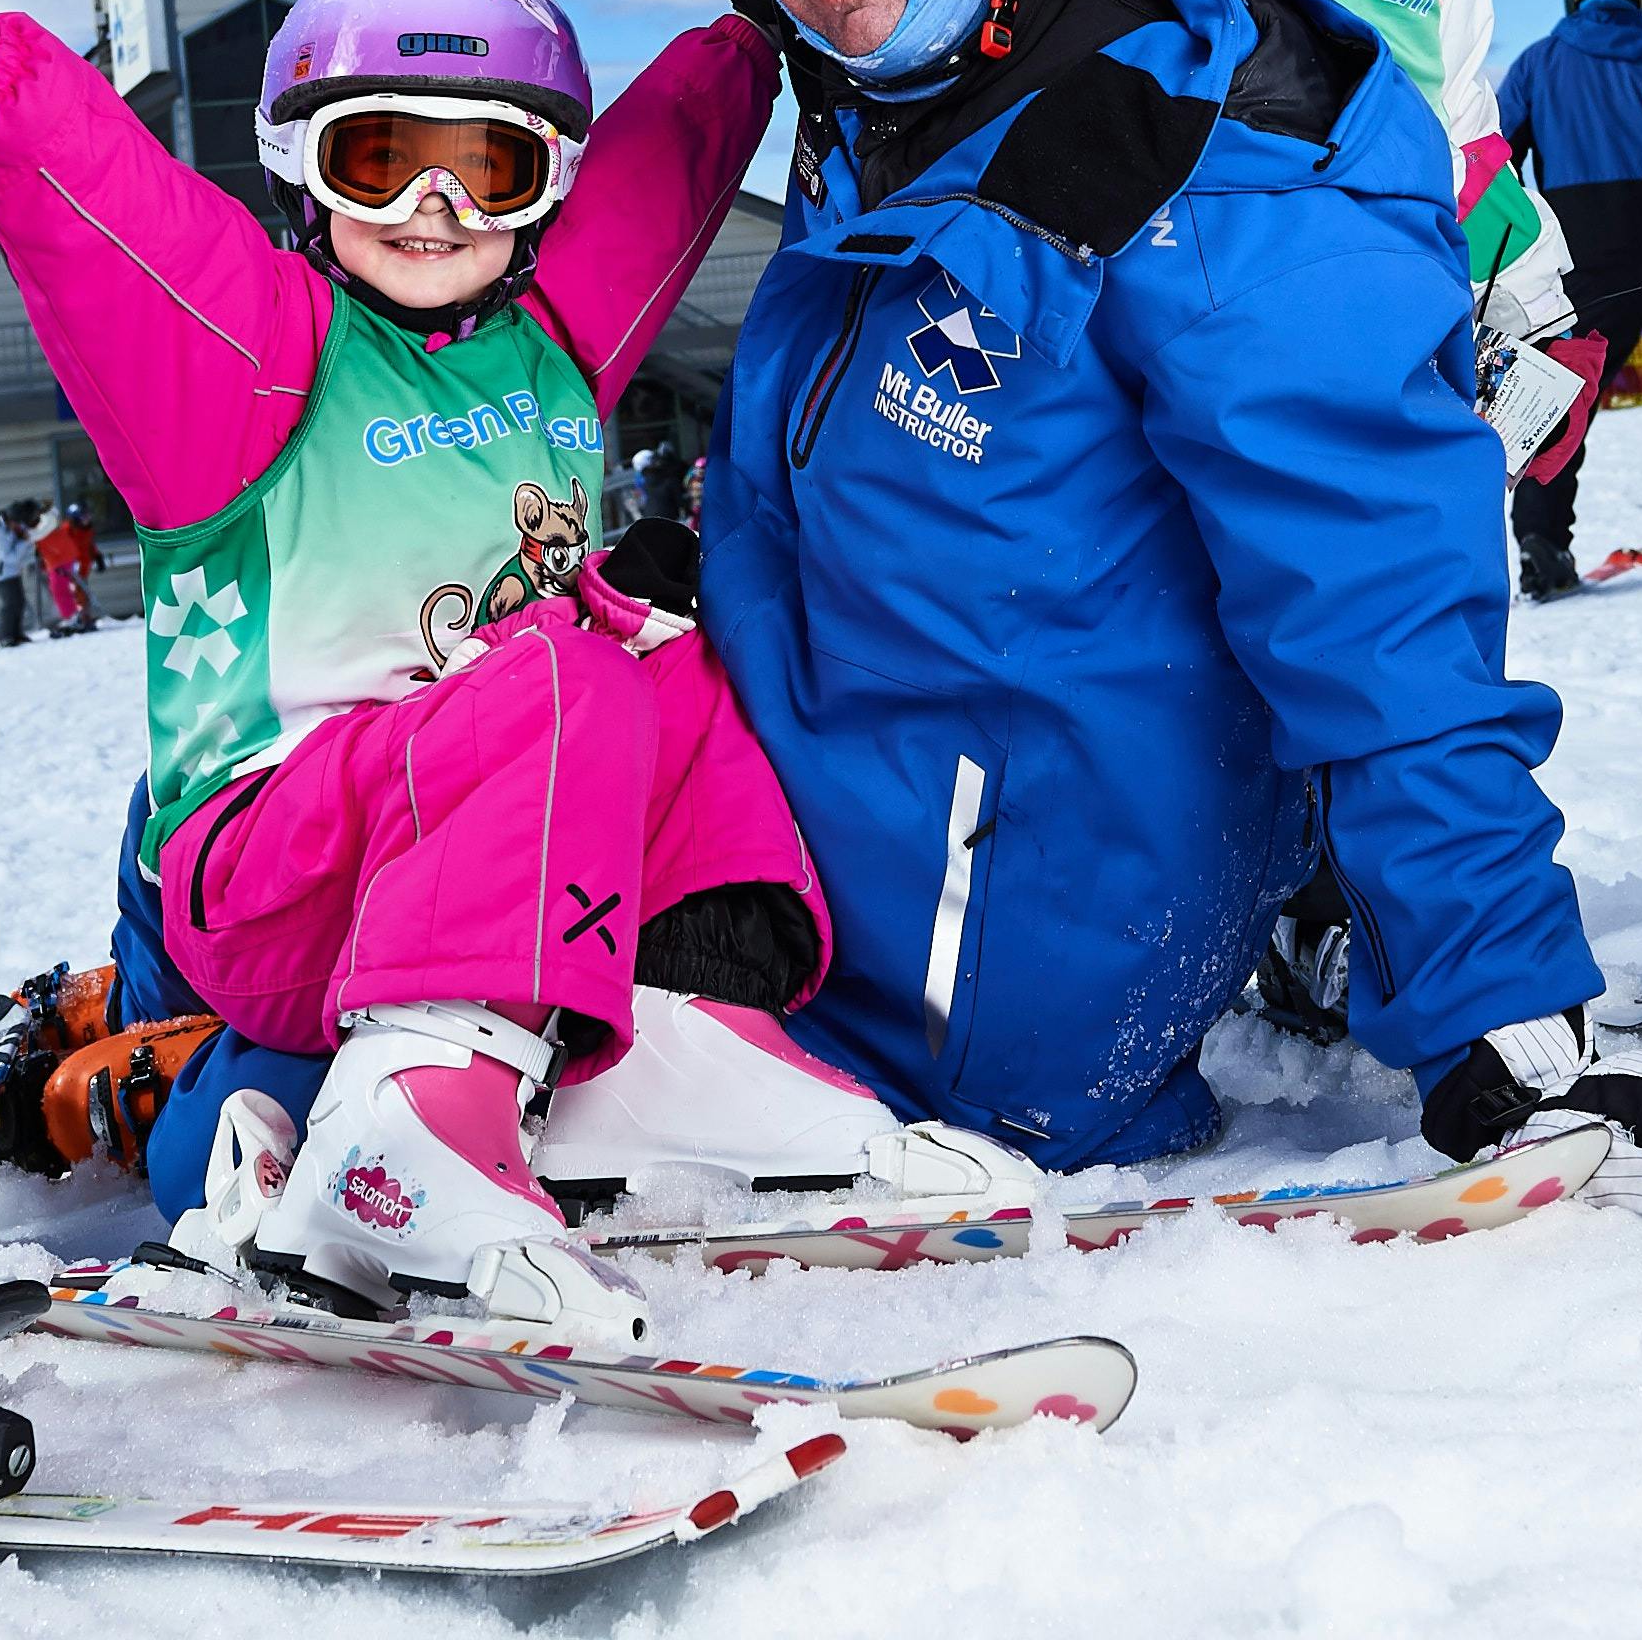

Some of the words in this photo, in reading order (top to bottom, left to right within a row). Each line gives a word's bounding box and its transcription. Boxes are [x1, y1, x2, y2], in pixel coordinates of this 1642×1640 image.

[363, 403, 511, 467] Green
[874, 392, 983, 464] INSTRUCTOR
[880, 363, 911, 406] Mt
[911, 384, 992, 444] Buller
[348, 1175, 404, 1223] salomon
